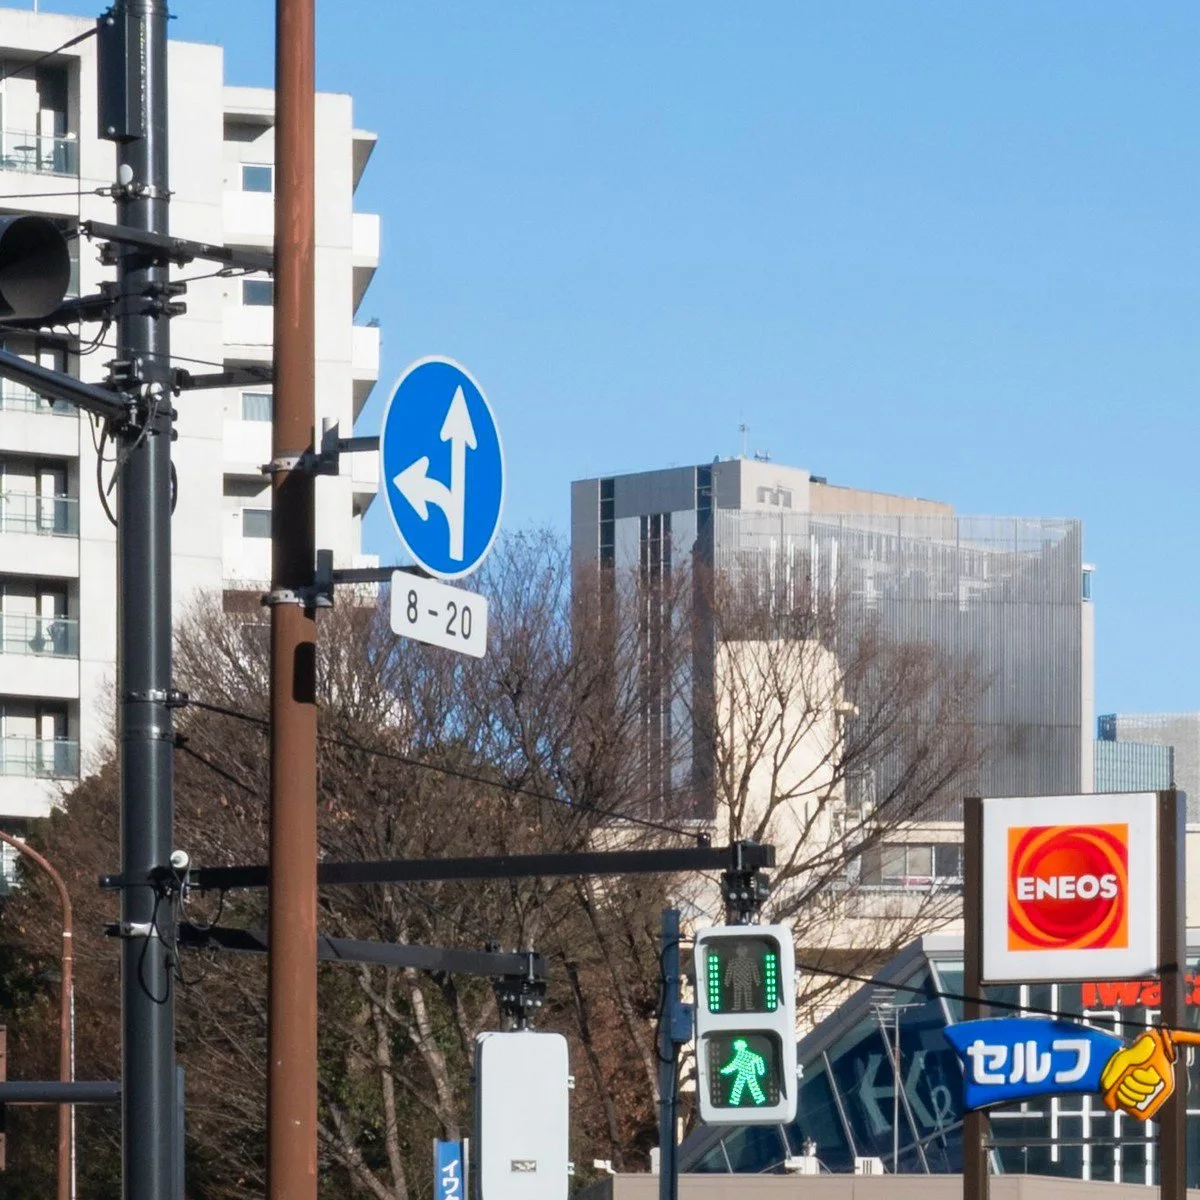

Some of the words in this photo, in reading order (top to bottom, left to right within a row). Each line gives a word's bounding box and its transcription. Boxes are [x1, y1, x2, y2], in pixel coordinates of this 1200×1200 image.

[1017, 874, 1118, 900] ENEOS
[967, 1039, 1091, 1085] セルフ
[441, 1159, 460, 1200] イワ
